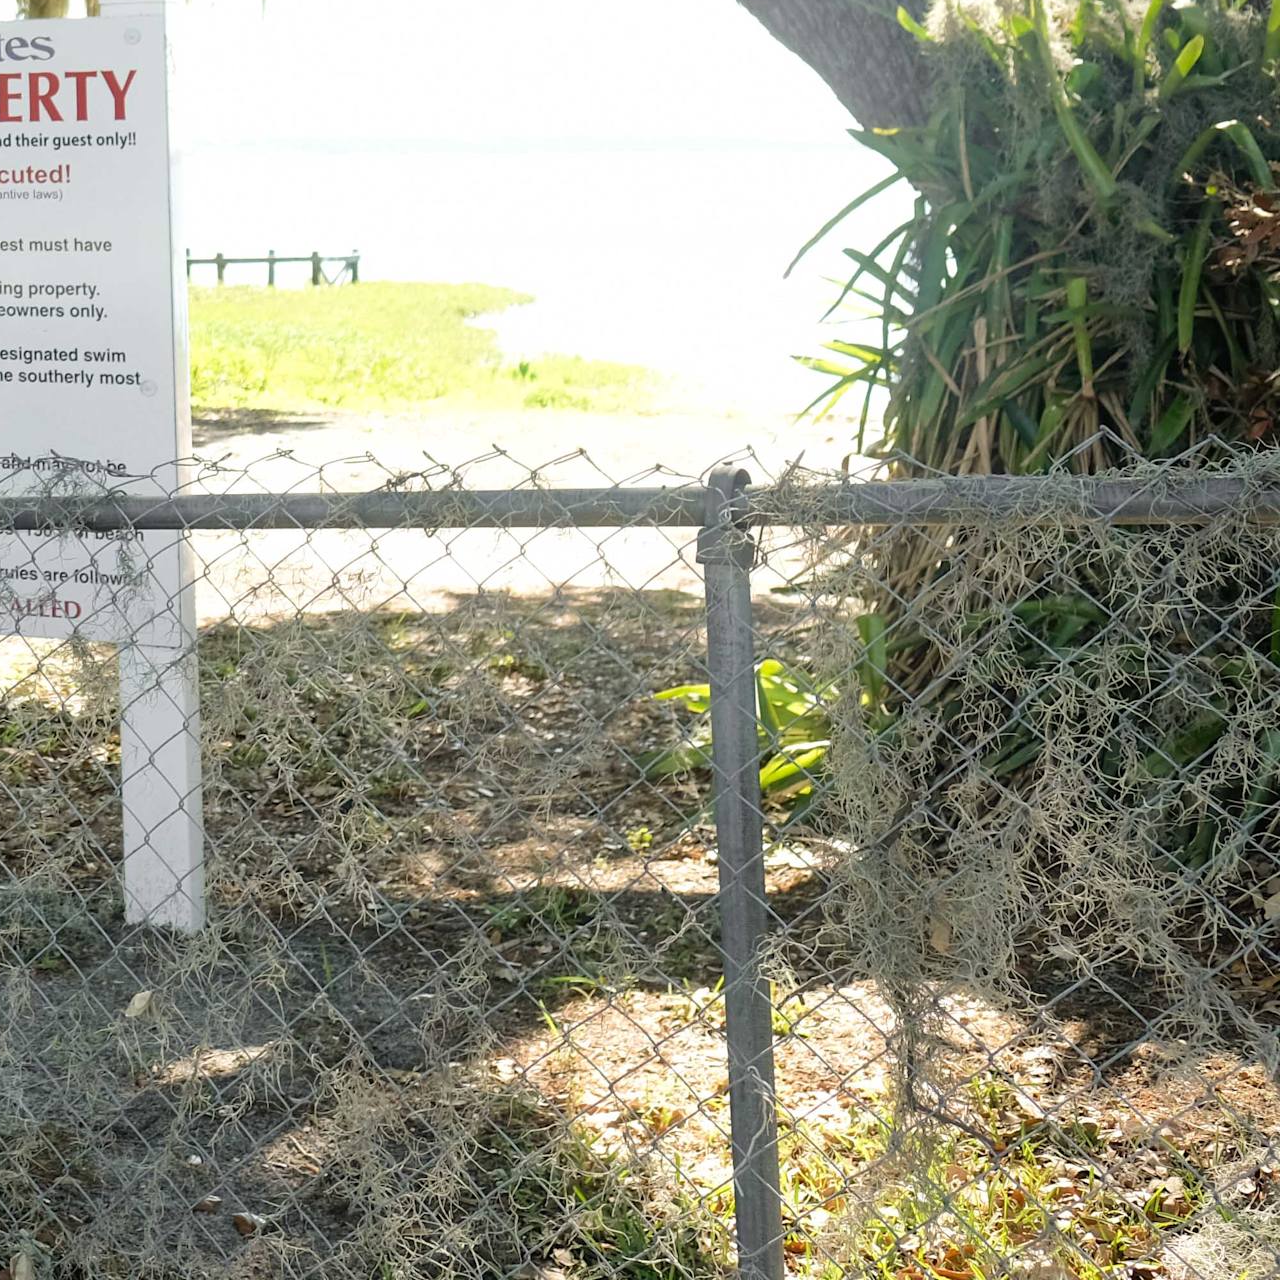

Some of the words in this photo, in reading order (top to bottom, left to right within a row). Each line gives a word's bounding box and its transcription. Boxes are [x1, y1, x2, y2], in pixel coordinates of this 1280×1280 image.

[15, 133, 49, 147] their
[53, 134, 92, 150] guest
[96, 131, 136, 149] only!!
[29, 239, 68, 252] must
[74, 238, 112, 252] have
[29, 283, 100, 300] property.
[70, 304, 107, 322] only.
[84, 348, 126, 363] swim
[18, 369, 94, 388] southerly
[99, 372, 142, 386] most
